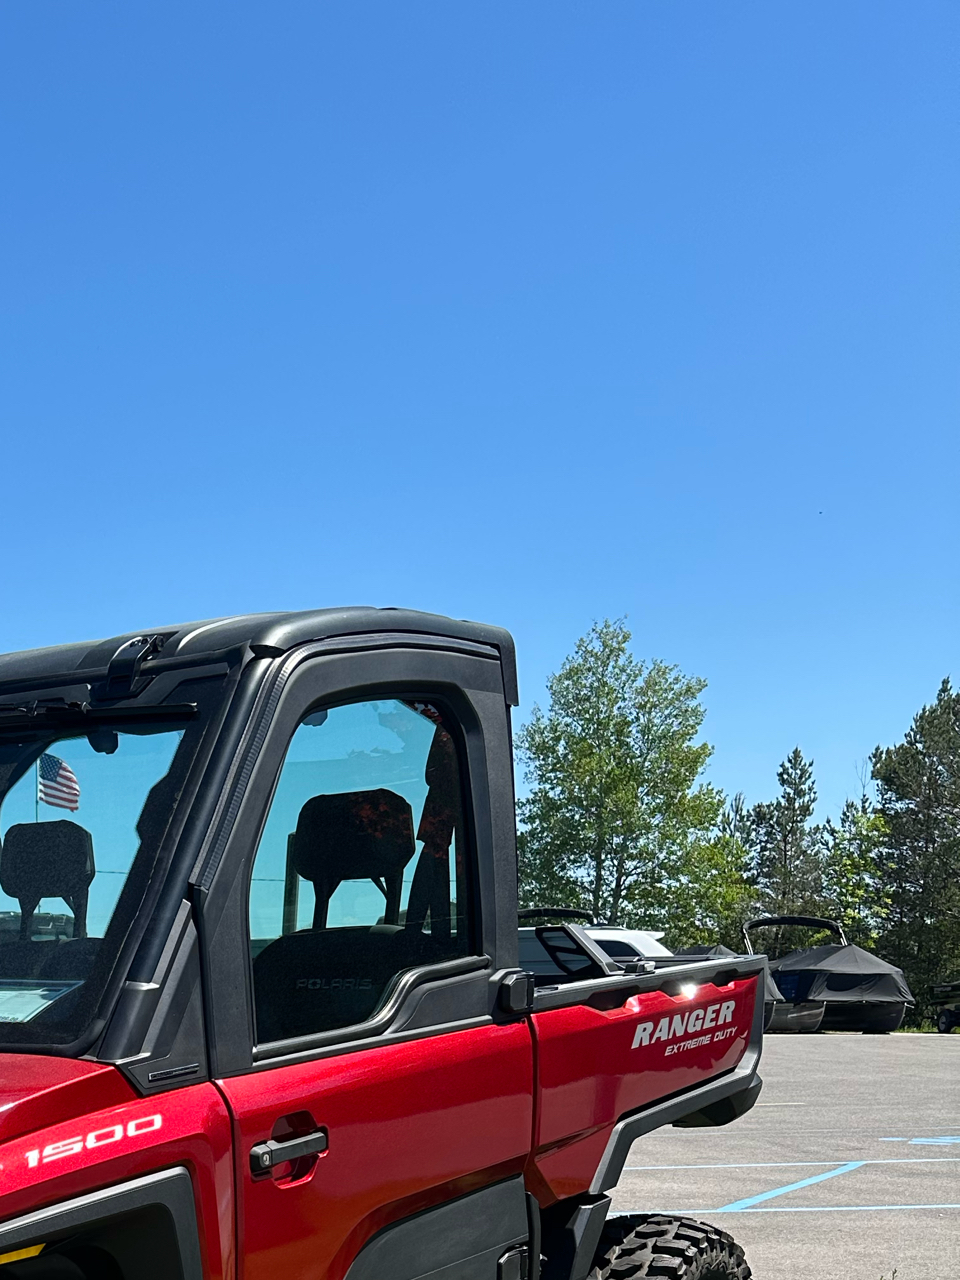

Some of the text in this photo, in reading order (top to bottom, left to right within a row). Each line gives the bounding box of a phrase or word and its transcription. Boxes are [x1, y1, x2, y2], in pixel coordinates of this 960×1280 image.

[296, 979, 372, 990] POLARIS
[631, 1000, 736, 1049] RANGER
[664, 1026, 738, 1056] EXTREME DUTY
[25, 1114, 162, 1168] 1500
